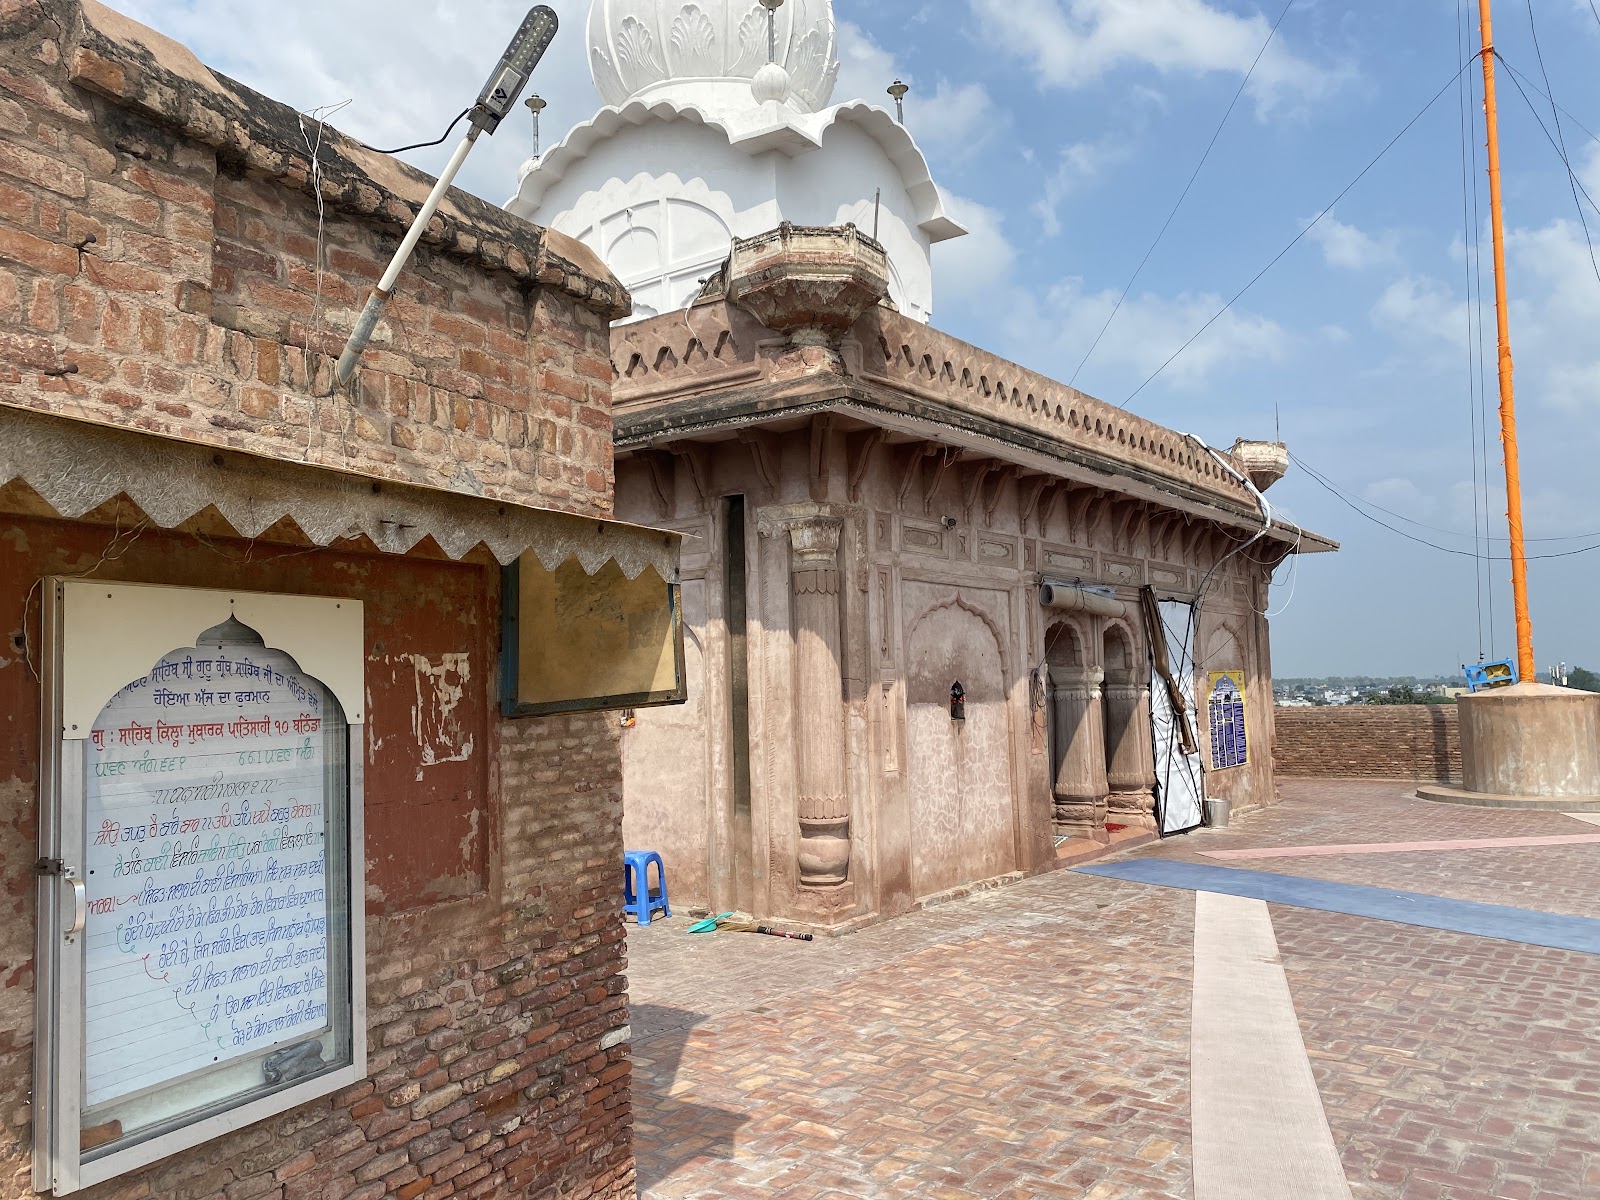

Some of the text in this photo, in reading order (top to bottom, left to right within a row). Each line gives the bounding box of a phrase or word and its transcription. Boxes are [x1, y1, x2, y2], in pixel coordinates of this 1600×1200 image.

[152, 659, 179, 683] ਸਾਹਿਬ
[182, 655, 193, 680] ਸ੍ਰੀ
[235, 657, 261, 682] ਸਾਹਿਬ
[263, 664, 273, 686] ਜੀ
[275, 672, 285, 686] ਦਾ
[153, 687, 271, 708] ਹੋਇਆ ਅੱਜ ਦਾ ਫੁਰਮਾਨ
[118, 720, 154, 747] ਸਾਹਿਬ
[187, 723, 224, 744] ਮੁਬਾਰਕ
[274, 720, 289, 737] ੧੦
[292, 712, 322, 736] ਬਠਿੰਡਾ
[239, 750, 262, 767] 661
[149, 813, 157, 838] ਹੈ
